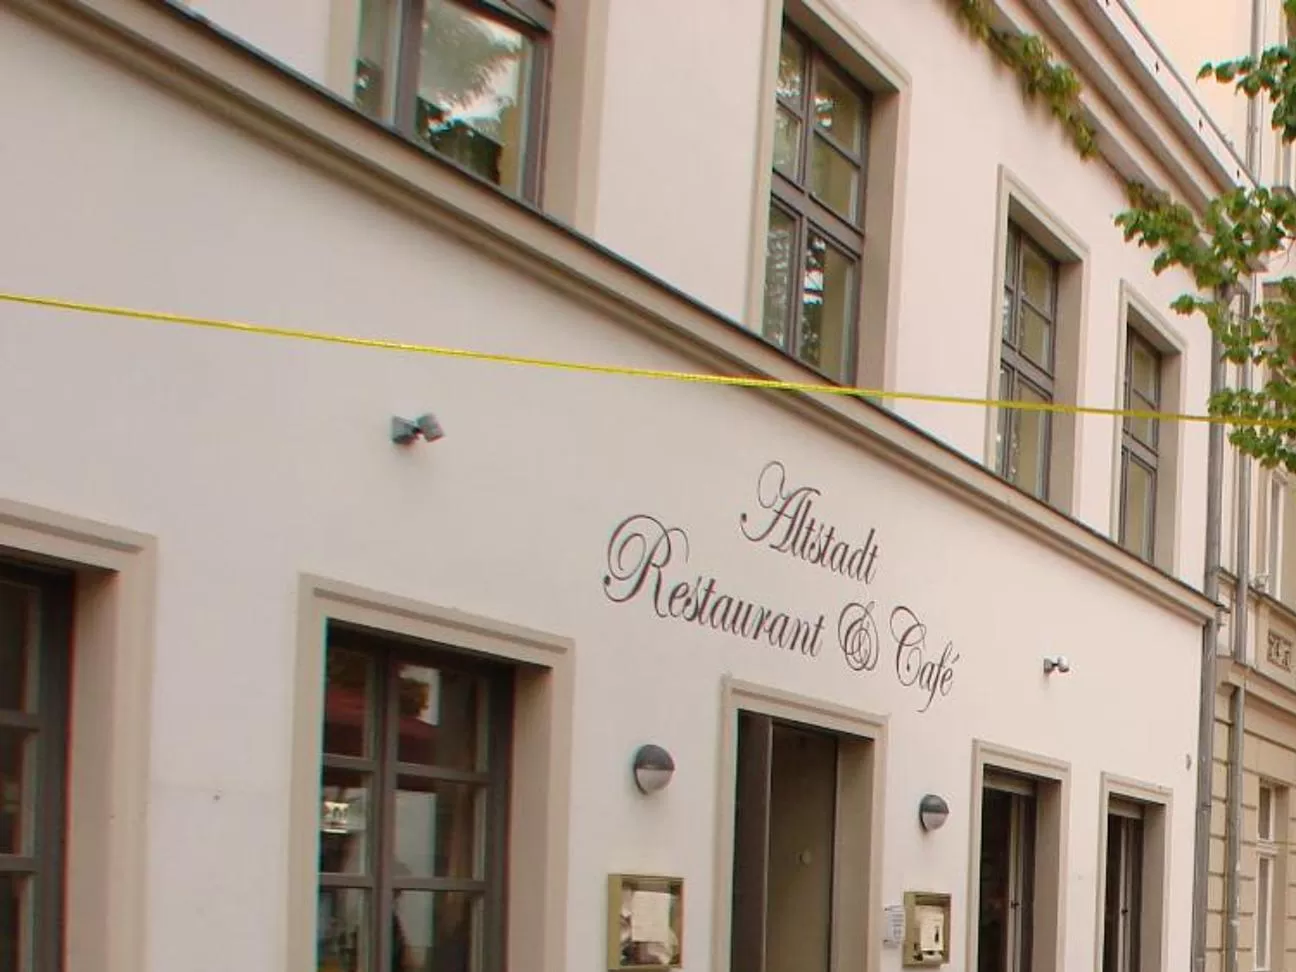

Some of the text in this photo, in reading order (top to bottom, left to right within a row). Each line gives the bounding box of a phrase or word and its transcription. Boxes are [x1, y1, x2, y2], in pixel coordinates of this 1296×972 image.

[741, 461, 879, 584] Altstadt
[603, 515, 961, 713] Restaurant & Café
